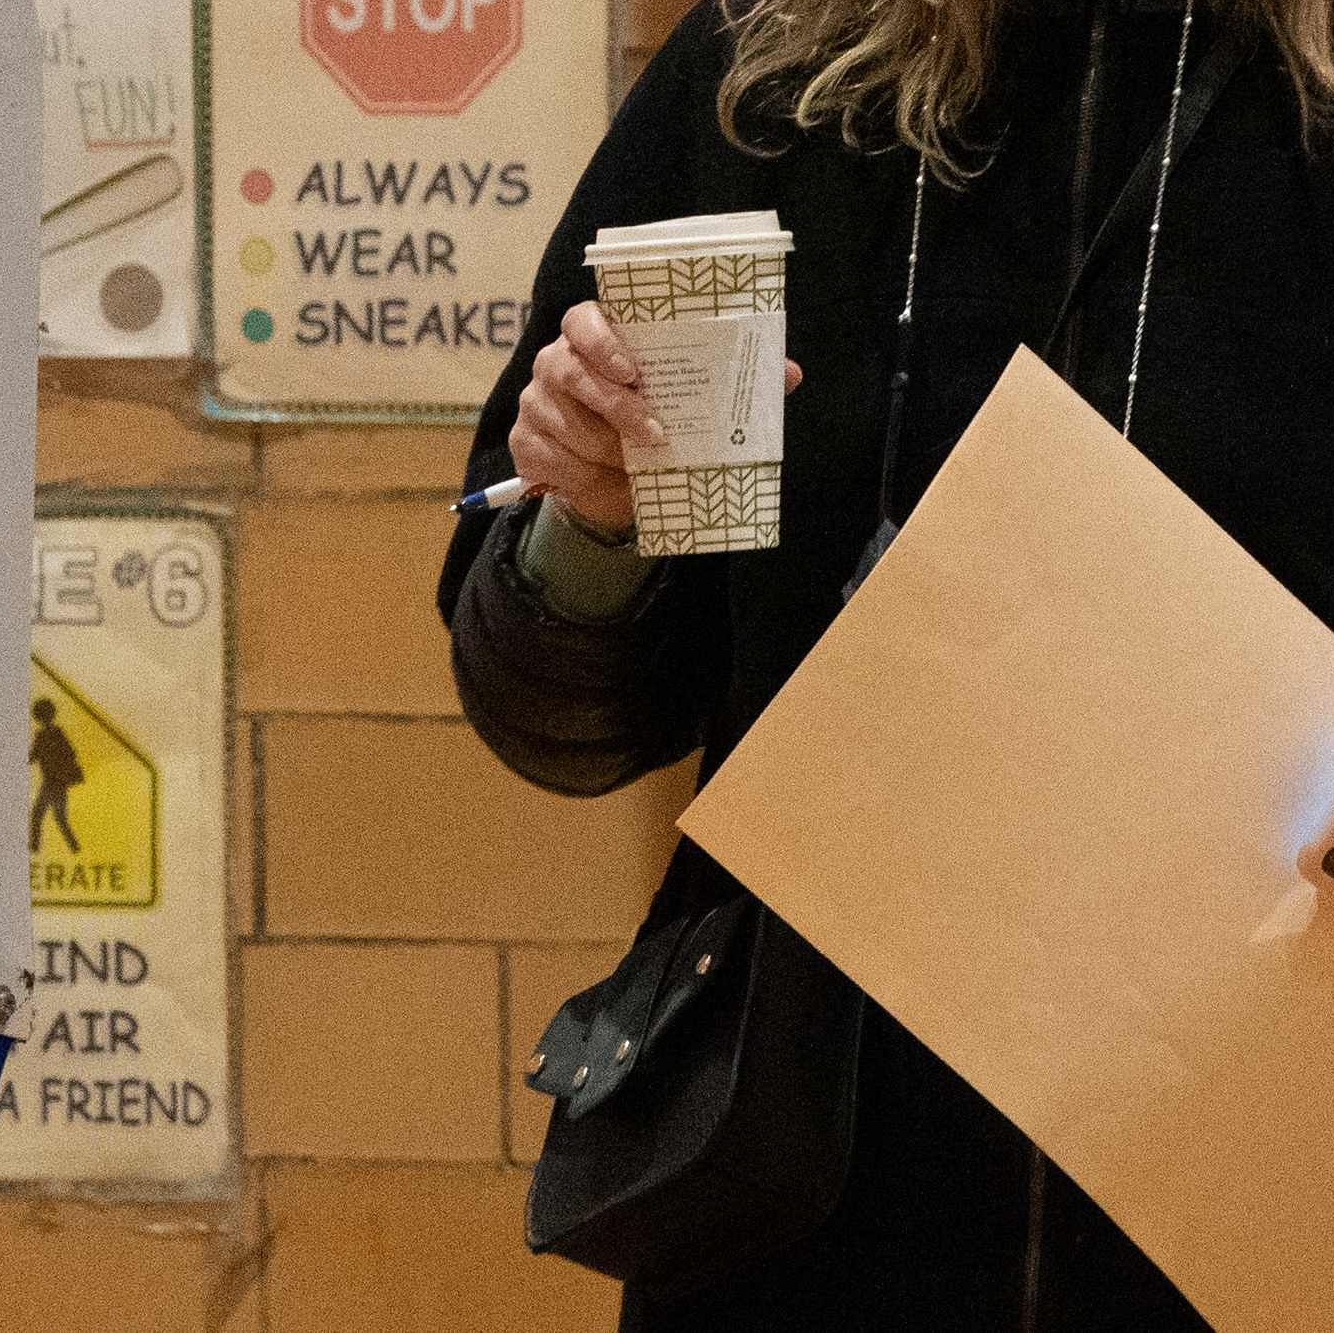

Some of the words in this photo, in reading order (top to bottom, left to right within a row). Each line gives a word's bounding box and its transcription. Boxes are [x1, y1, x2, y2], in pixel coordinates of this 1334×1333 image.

[73, 73, 179, 140] FUN!
[295, 160, 530, 207] ALWAYS
[293, 228, 457, 278] WEAR
[111, 541, 209, 630] #6
[36, 938, 150, 988] IND
[29, 1010, 143, 1054] AIR
[39, 1074, 213, 1127] FRIEND
